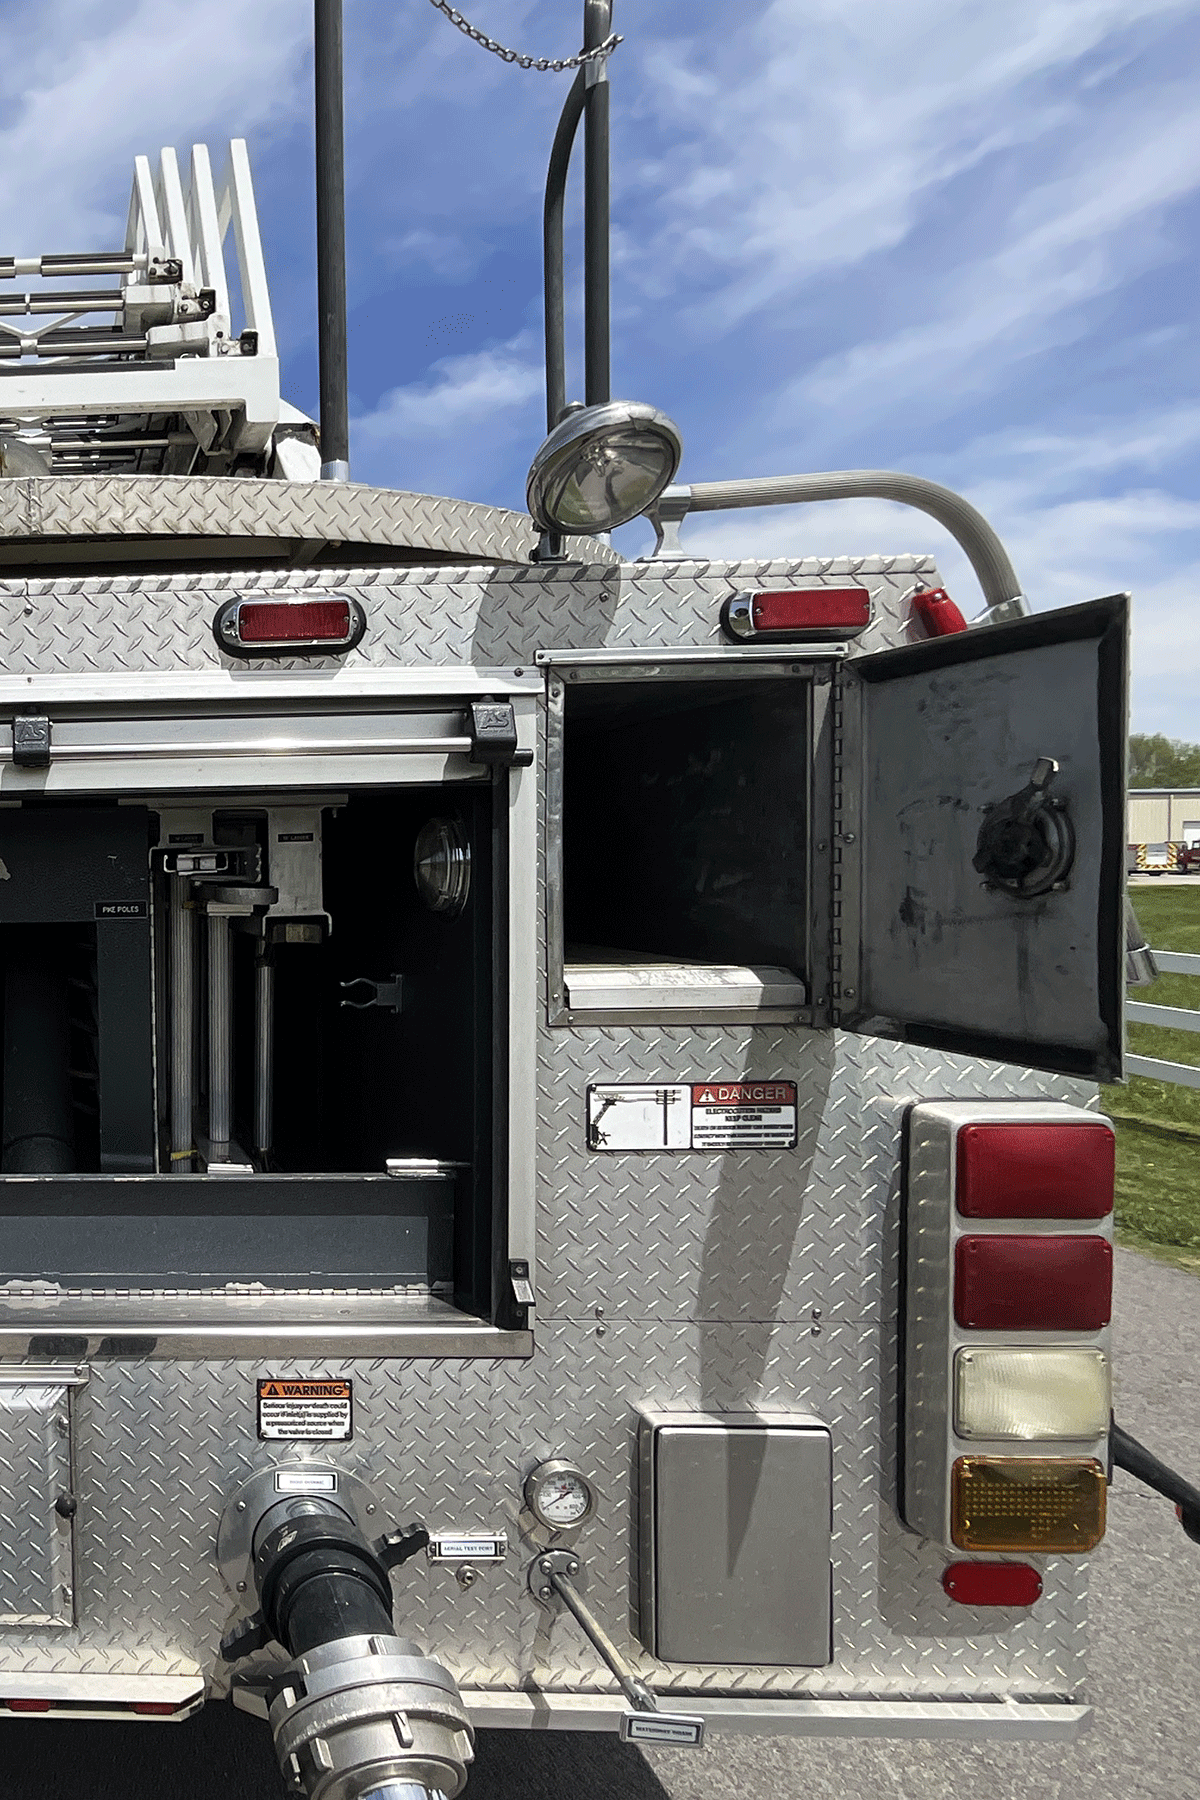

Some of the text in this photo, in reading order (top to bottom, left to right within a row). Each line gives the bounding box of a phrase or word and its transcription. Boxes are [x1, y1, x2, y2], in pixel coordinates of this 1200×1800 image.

[102, 905, 139, 914] PIKE POLES
[718, 1087, 786, 1100] DANGER
[282, 1385, 343, 1396] WARNING
